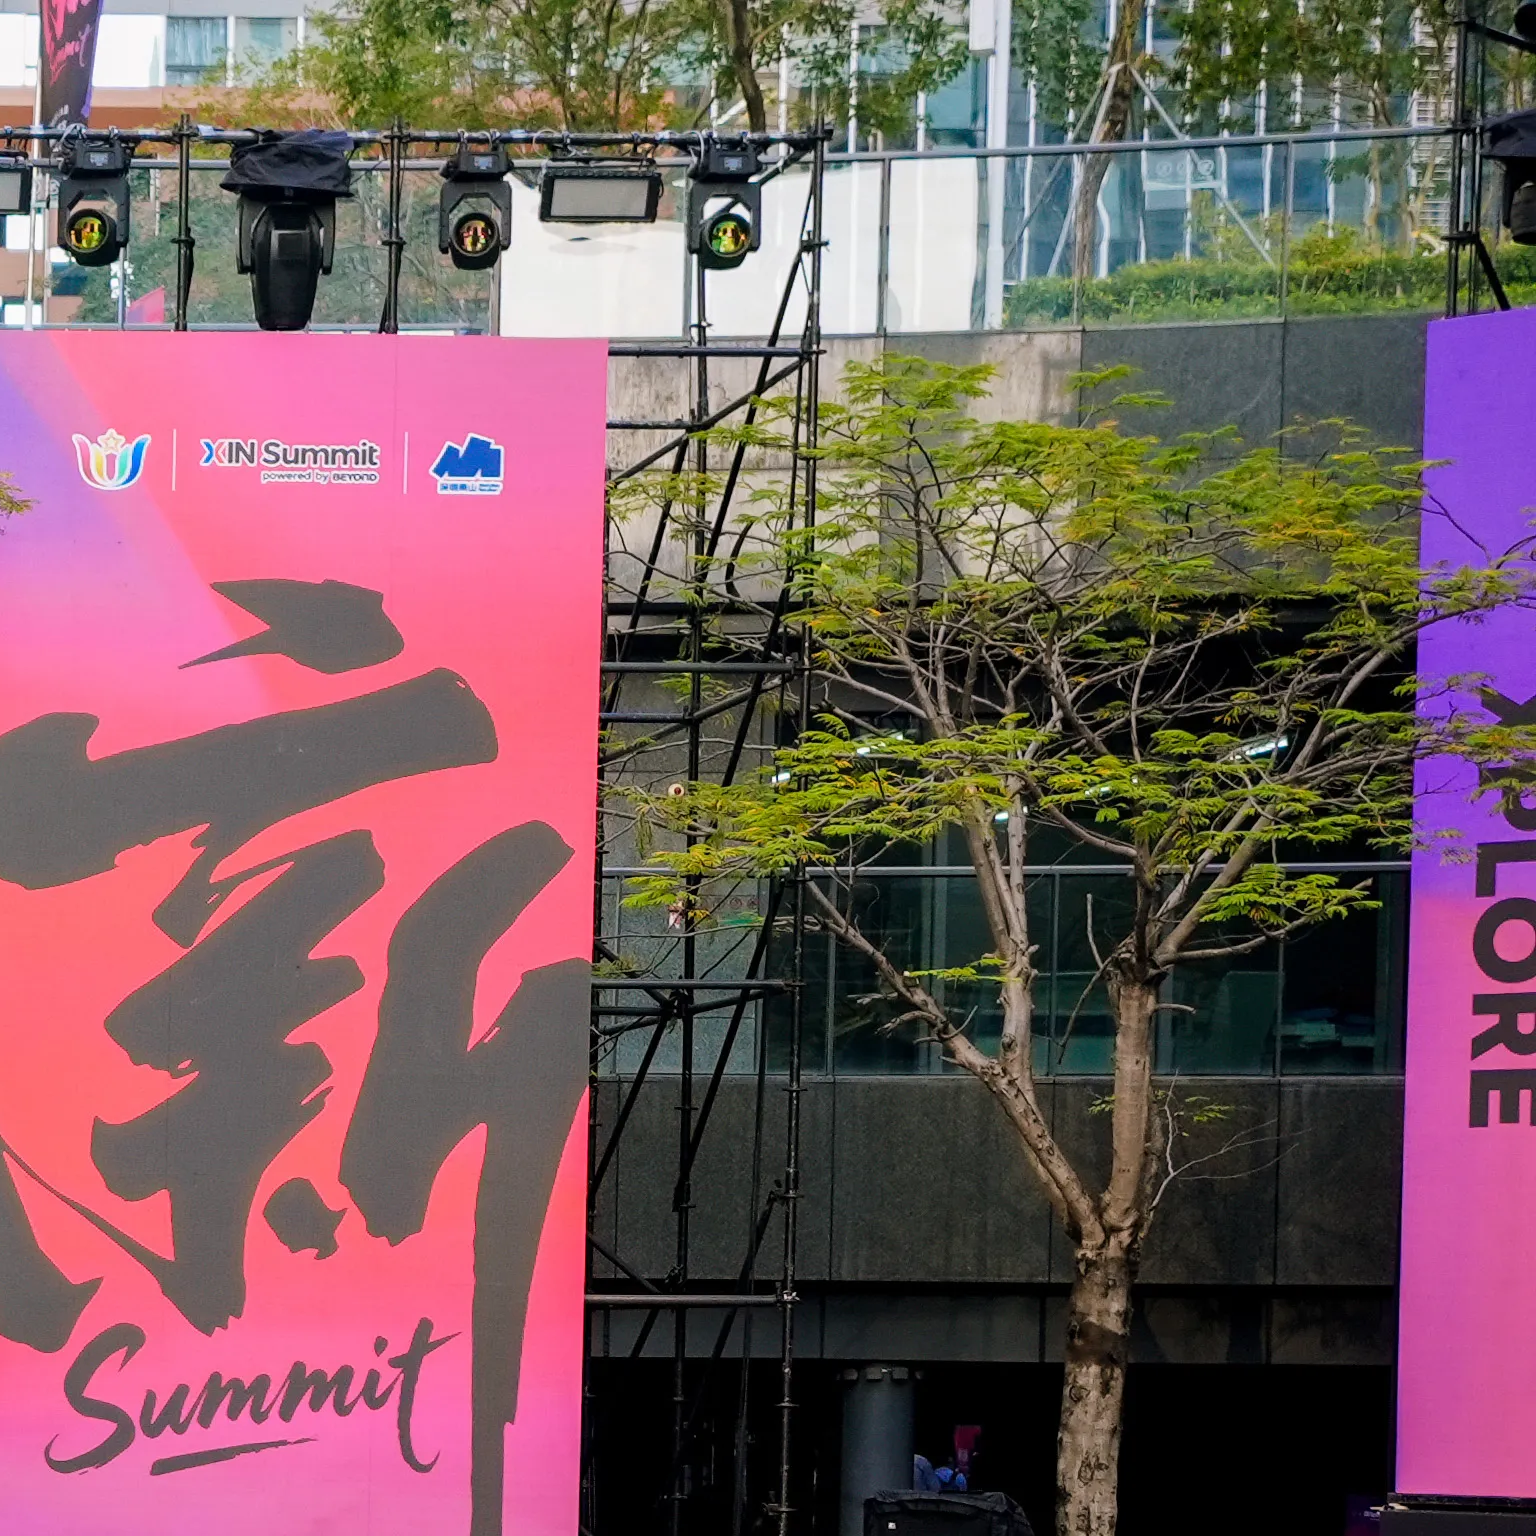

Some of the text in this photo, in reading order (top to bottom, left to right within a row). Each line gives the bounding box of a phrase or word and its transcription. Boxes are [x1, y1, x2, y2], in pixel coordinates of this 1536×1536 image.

[202, 440, 379, 466] XIN Summit
[262, 471, 377, 483] powered by BEYOND
[44, 1315, 462, 1474] Summit
